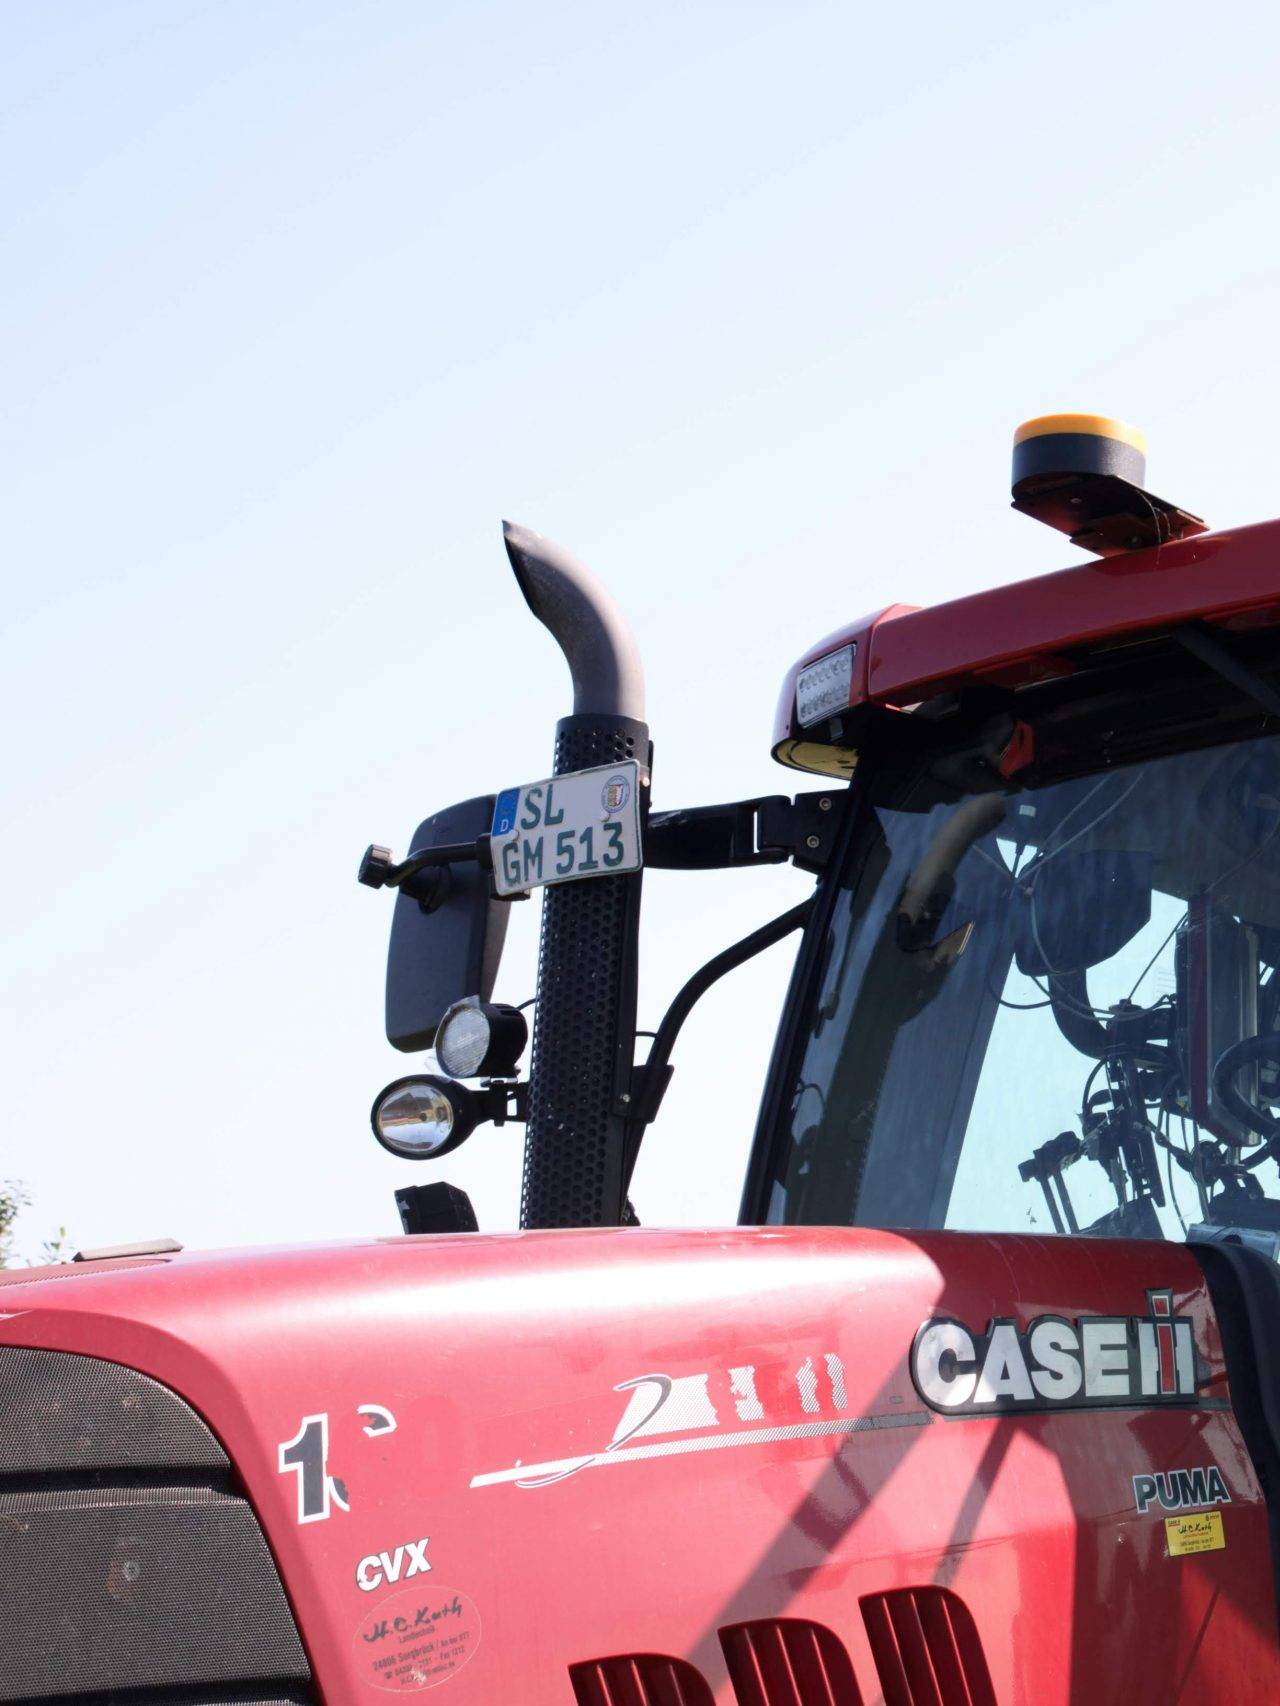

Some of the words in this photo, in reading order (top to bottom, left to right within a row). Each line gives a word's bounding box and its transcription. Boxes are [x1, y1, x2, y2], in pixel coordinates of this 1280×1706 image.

[500, 819, 509, 832] D
[520, 784, 564, 830] SL
[502, 837, 544, 885] GM
[556, 821, 624, 875] 513
[913, 1320, 1130, 1407] CASE
[1133, 1466, 1231, 1513] PUMA
[356, 1536, 432, 1592] CVX
